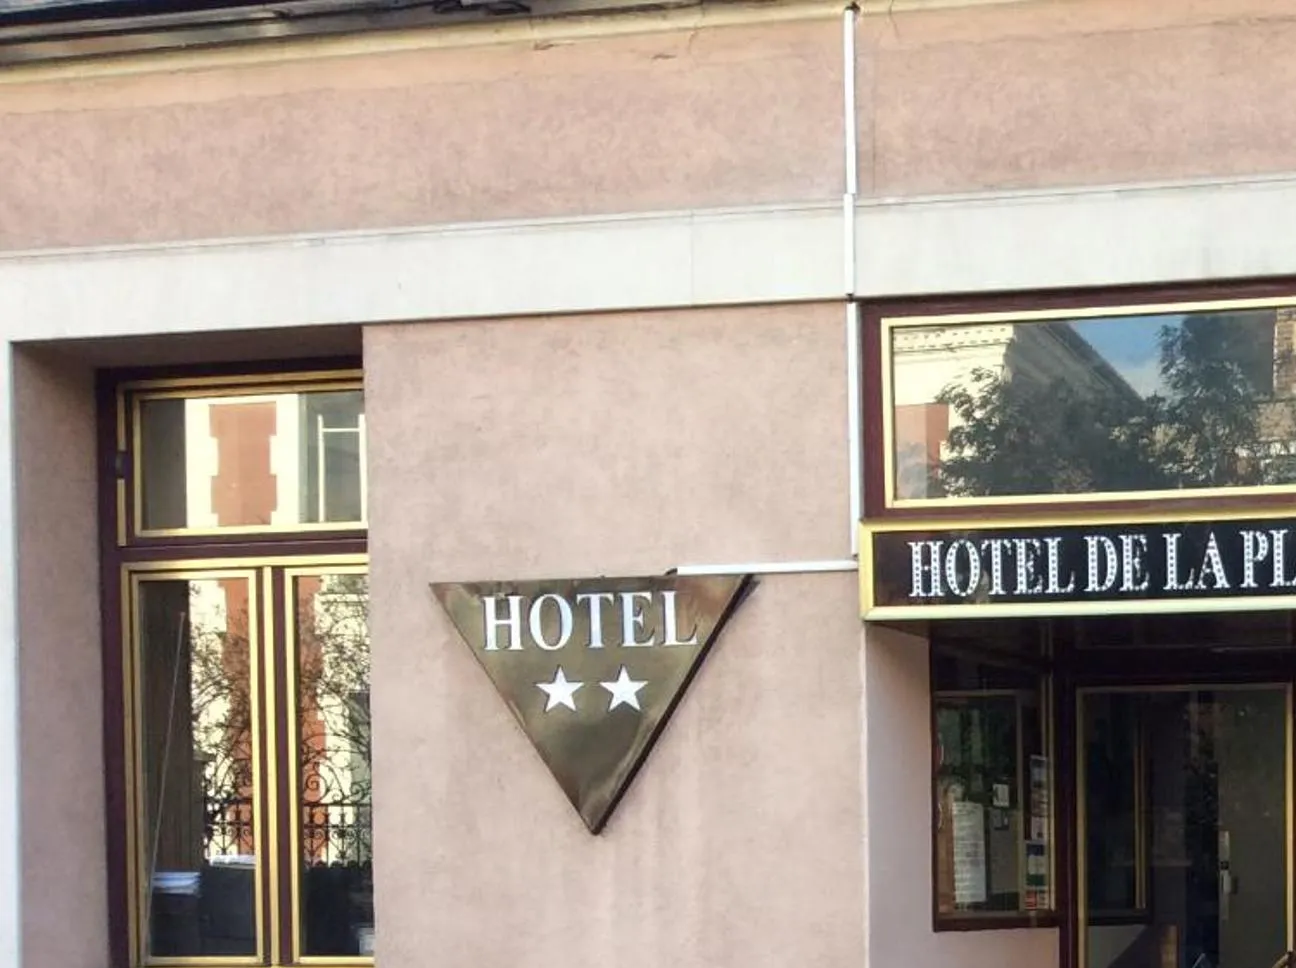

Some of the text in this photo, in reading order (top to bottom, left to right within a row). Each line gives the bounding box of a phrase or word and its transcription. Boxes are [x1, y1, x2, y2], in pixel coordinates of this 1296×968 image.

[908, 537, 1076, 598] HOTEL
[1084, 534, 1148, 593] DE
[1163, 531, 1231, 591] LA
[482, 590, 698, 650] HOTEL
